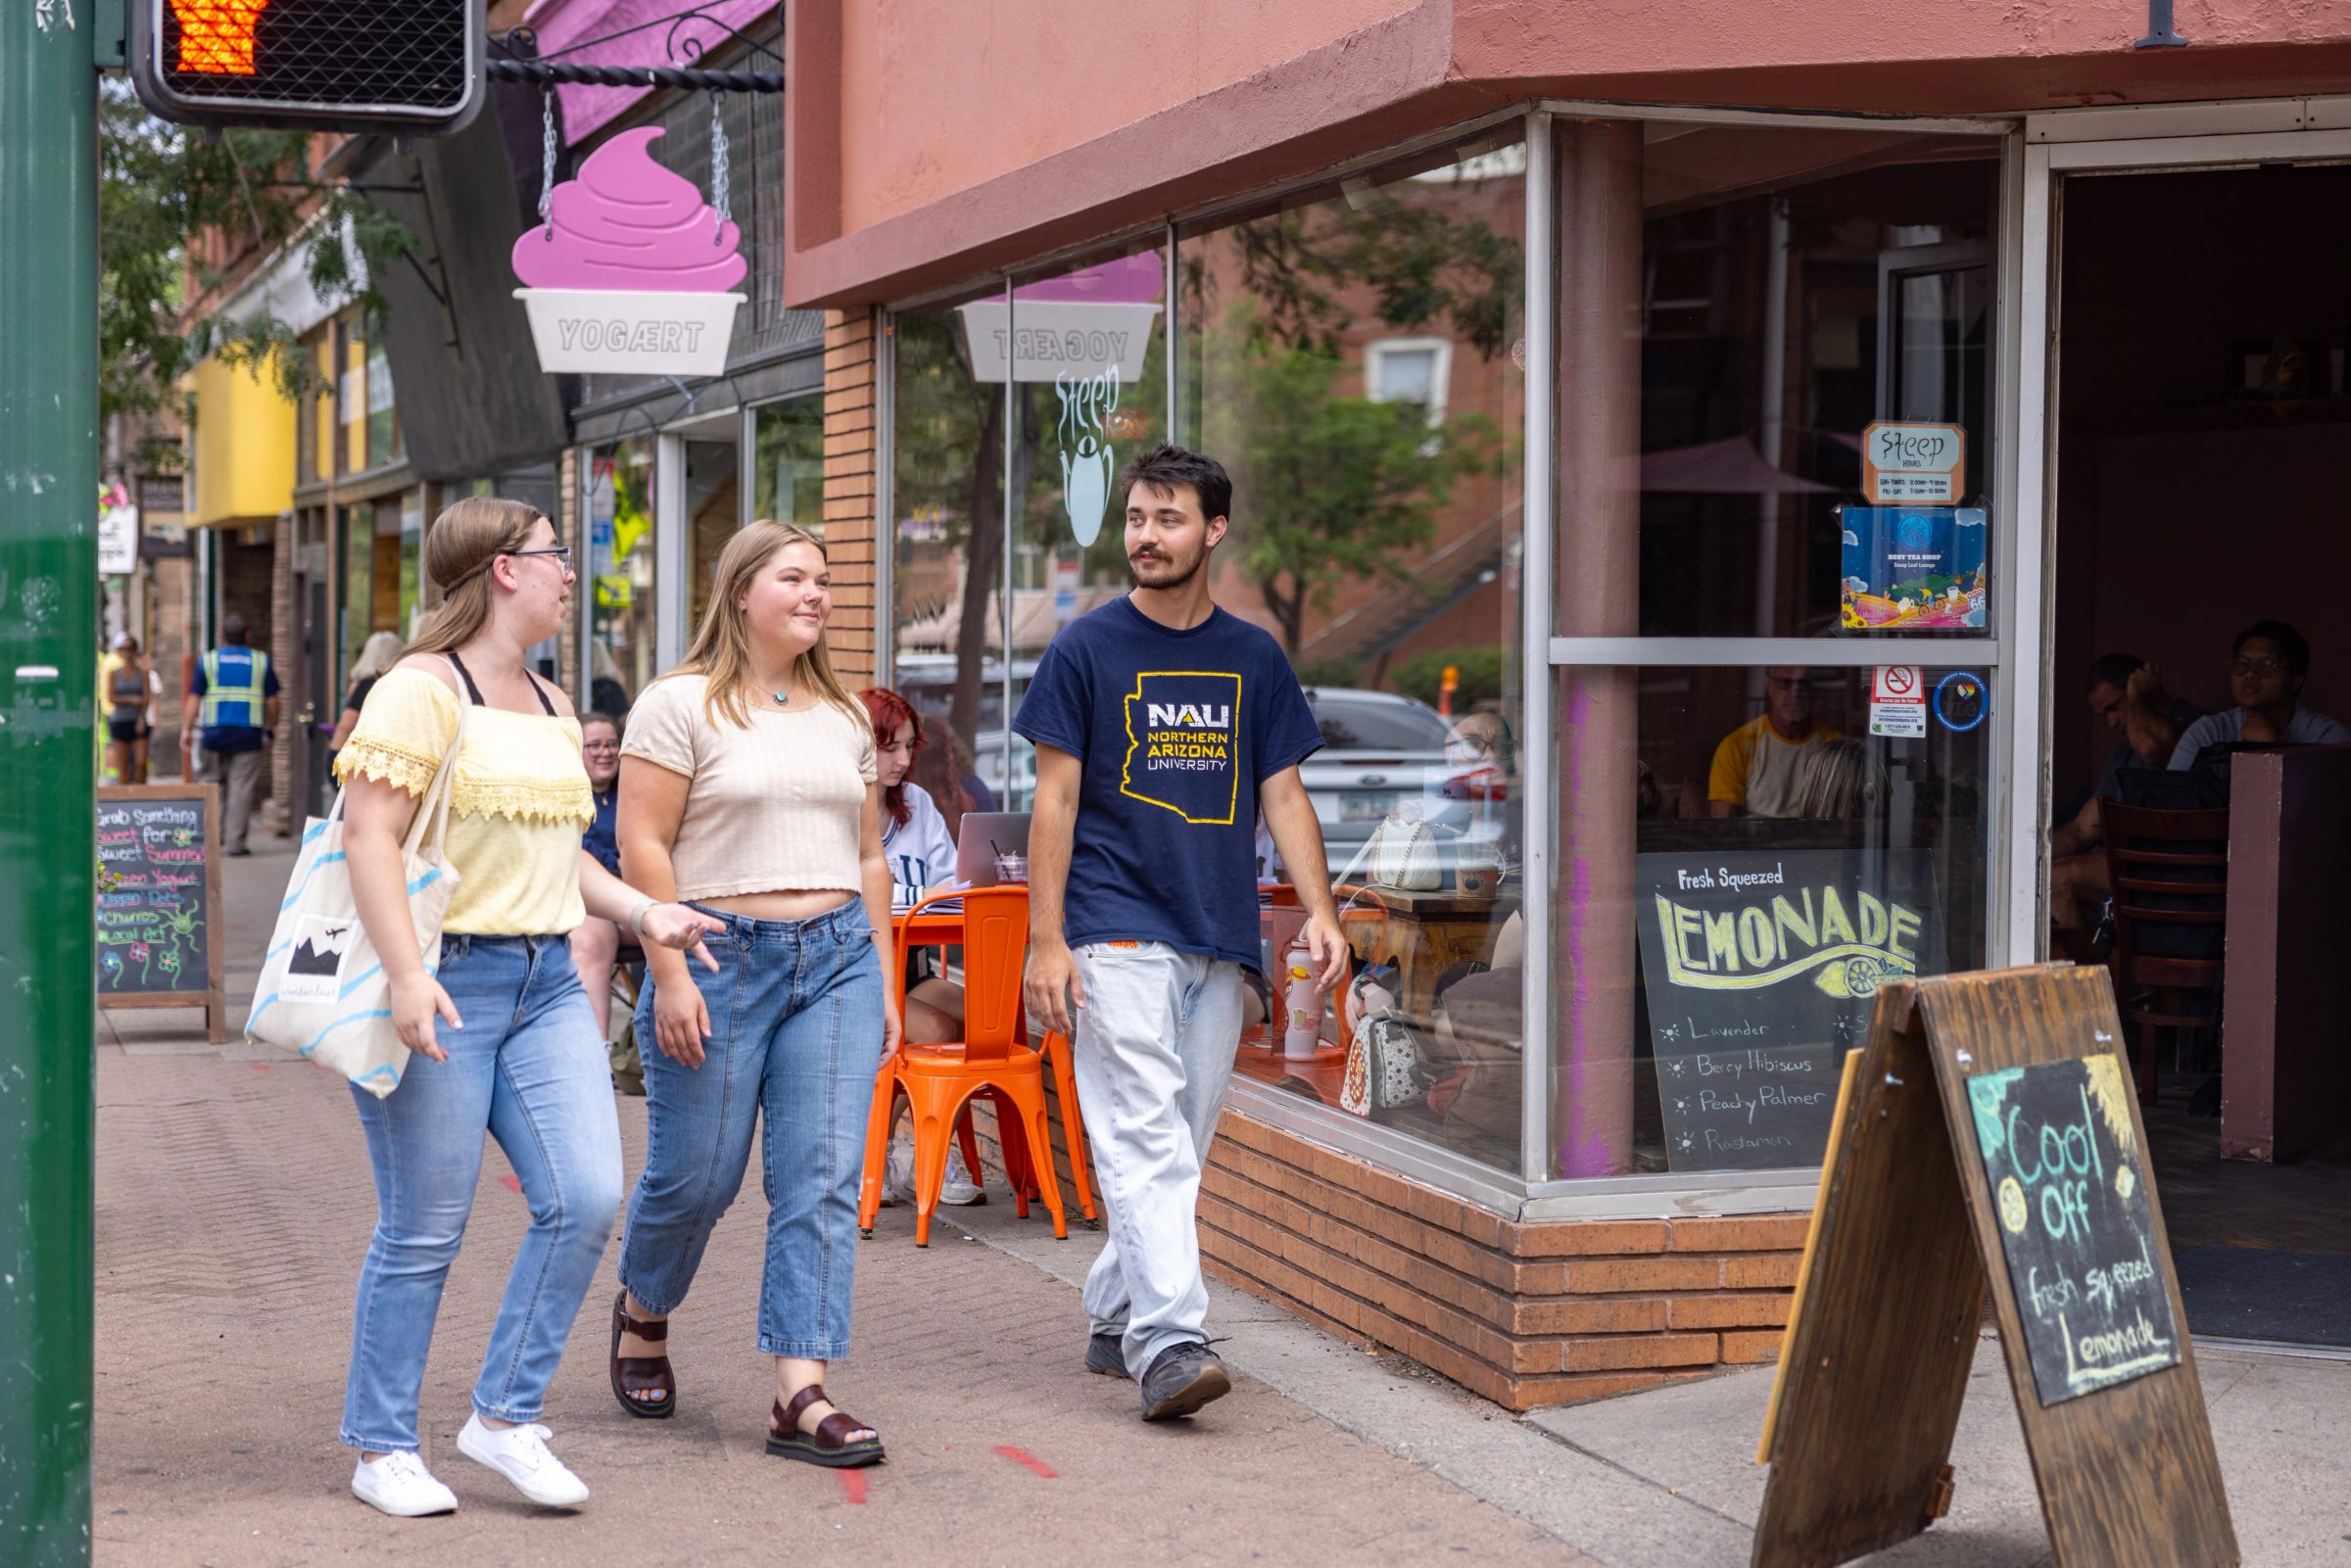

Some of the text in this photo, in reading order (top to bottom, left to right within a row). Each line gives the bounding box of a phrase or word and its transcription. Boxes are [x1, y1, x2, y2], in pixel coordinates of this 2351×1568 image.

[1902, 459, 1922, 468] HOURS
[1969, 595, 1986, 610] 66
[1147, 703, 1229, 728] NAU
[1147, 732, 1228, 743] NORTHERN
[1147, 744, 1227, 759] ARIZONA
[1147, 759, 1227, 772] UNIVERSITY
[143, 826, 171, 845] for
[1677, 862, 1784, 892] Fresh Squeezed
[1655, 885, 1922, 982] LEMONADE
[1687, 1017, 1770, 1039] Lavender
[1697, 1049, 1812, 1080] Berry Hibiscus
[1758, 1085, 1827, 1107] Palmer
[2006, 1082, 2105, 1186] Cool
[2039, 1179, 2092, 1246] Off
